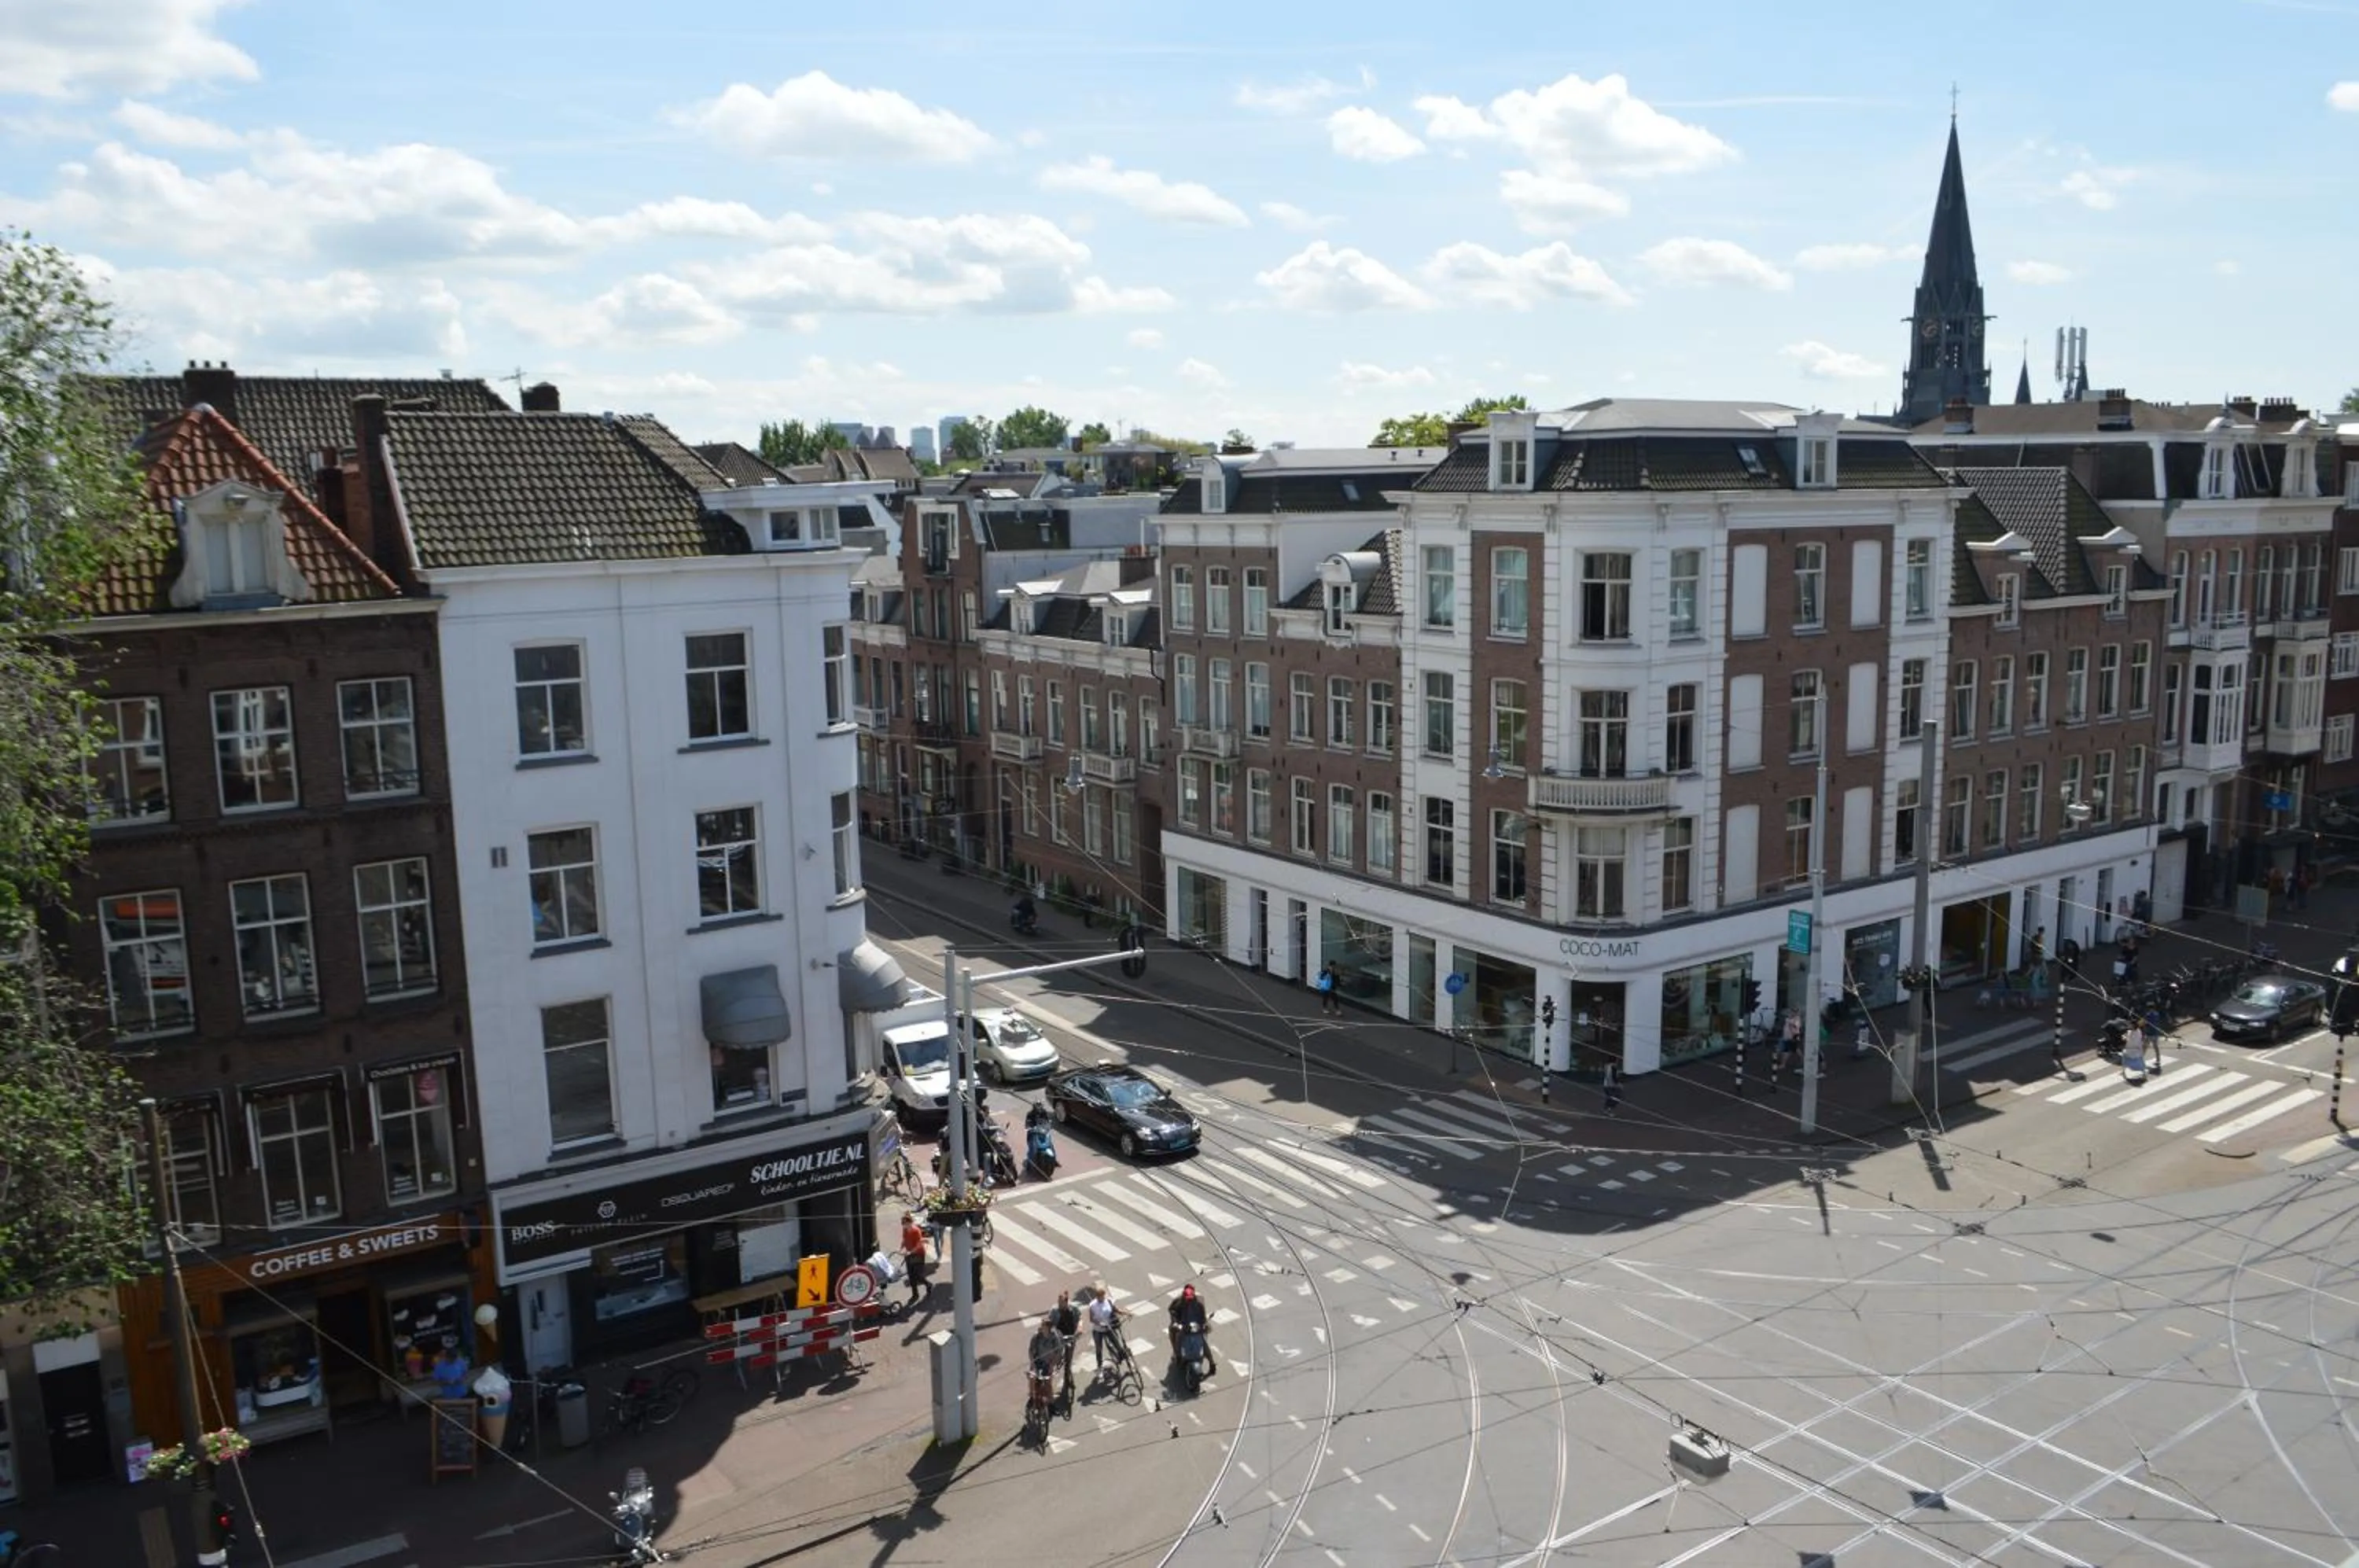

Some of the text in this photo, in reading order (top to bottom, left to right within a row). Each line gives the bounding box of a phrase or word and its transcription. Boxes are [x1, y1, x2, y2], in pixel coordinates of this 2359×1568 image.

[1560, 938, 1639, 956] COCO-MAT
[750, 1143, 864, 1183] SCHOOLTJE.NL
[512, 1220, 554, 1240] BOSS
[250, 1224, 440, 1278] COFFEE & SWEETS
